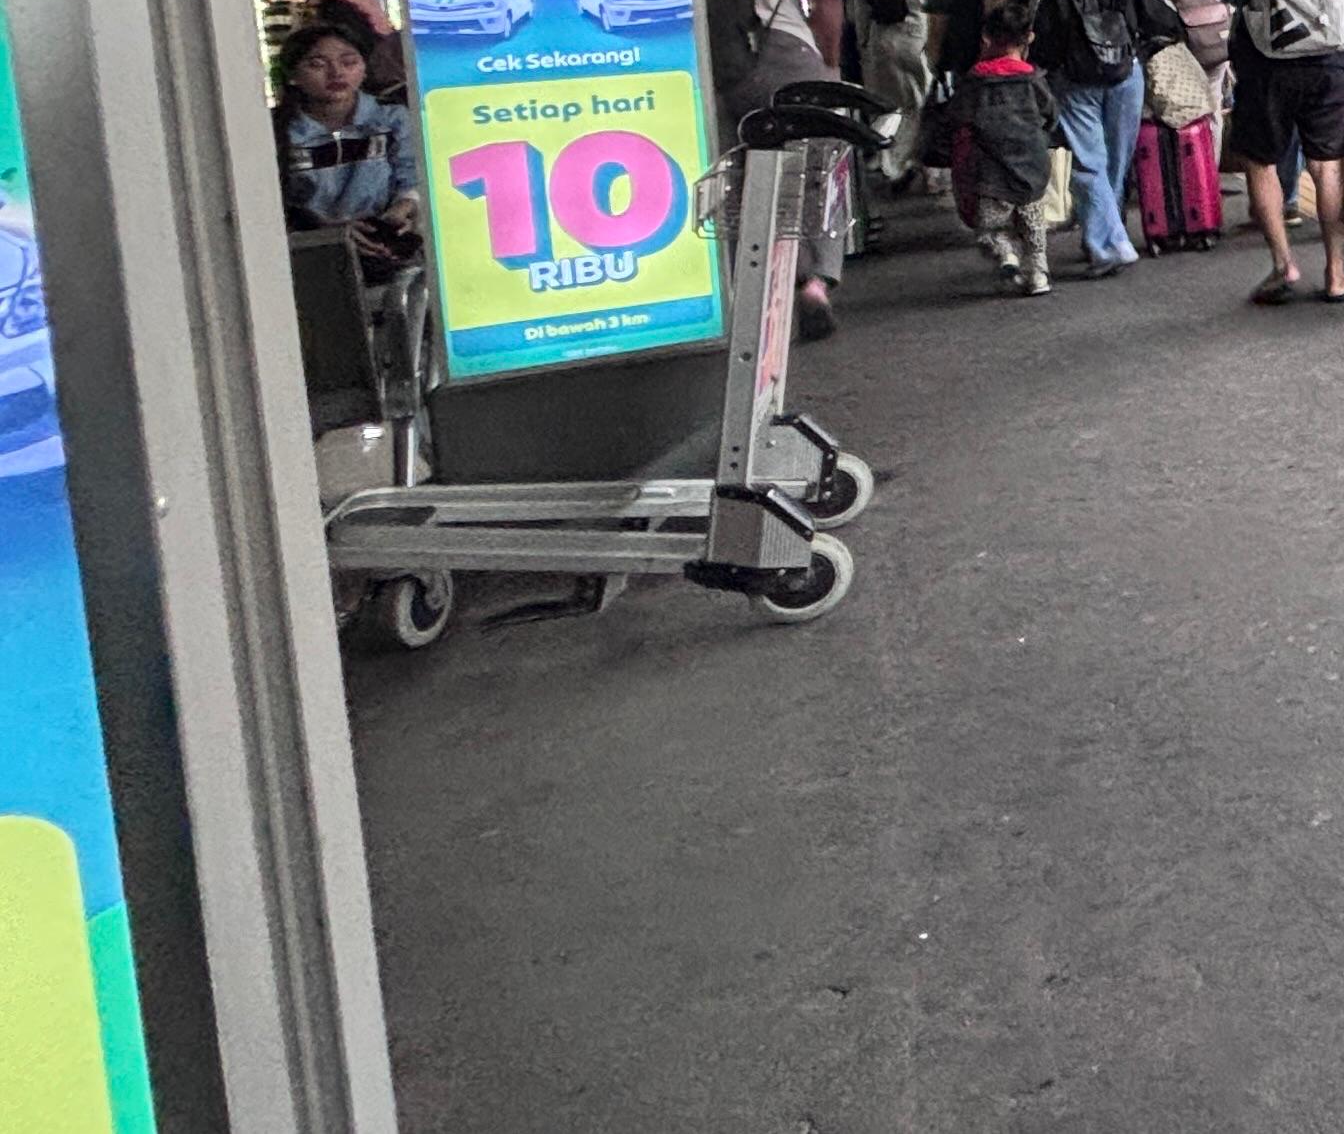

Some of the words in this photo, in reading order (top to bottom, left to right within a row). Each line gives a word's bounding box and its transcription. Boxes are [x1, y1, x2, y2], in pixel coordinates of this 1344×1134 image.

[477, 54, 522, 73] Cek
[472, 99, 583, 125] Setiap
[591, 89, 656, 115] hari
[448, 130, 689, 270] 10
[529, 251, 638, 292] RIBU
[524, 326, 544, 341] Di
[546, 316, 606, 337] bawah
[607, 315, 618, 329] 3
[622, 313, 649, 327] km
